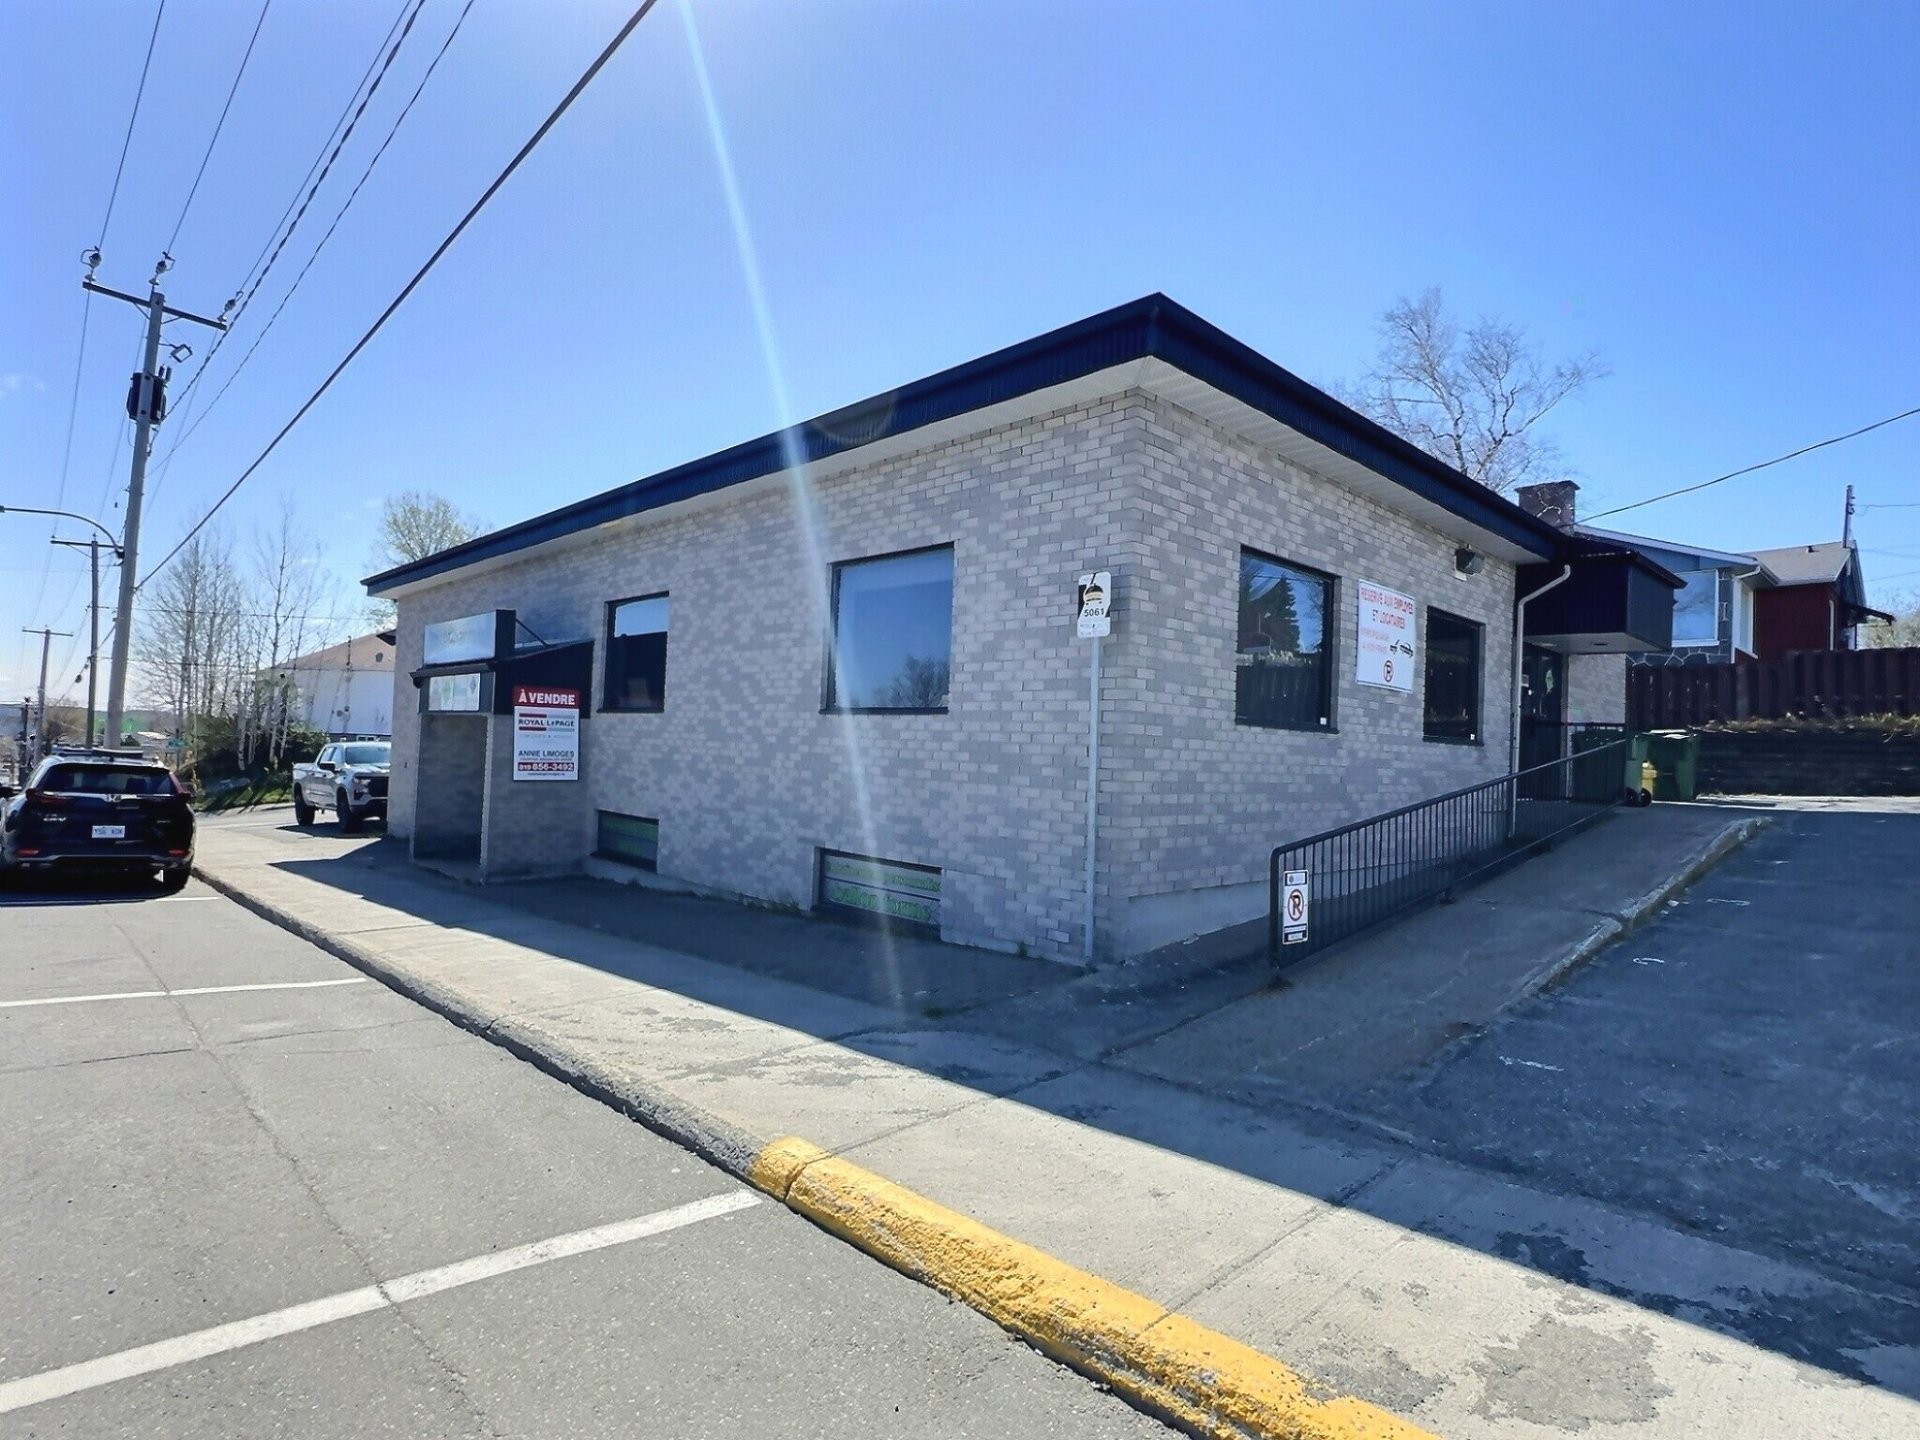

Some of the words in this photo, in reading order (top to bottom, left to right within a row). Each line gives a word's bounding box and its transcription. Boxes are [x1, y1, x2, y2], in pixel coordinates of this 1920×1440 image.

[1084, 608, 1104, 617] 5061
[518, 689, 528, 703] À
[528, 692, 576, 705] VENDRE
[518, 750, 541, 758] ANNIE
[542, 750, 575, 758] LIMOGES
